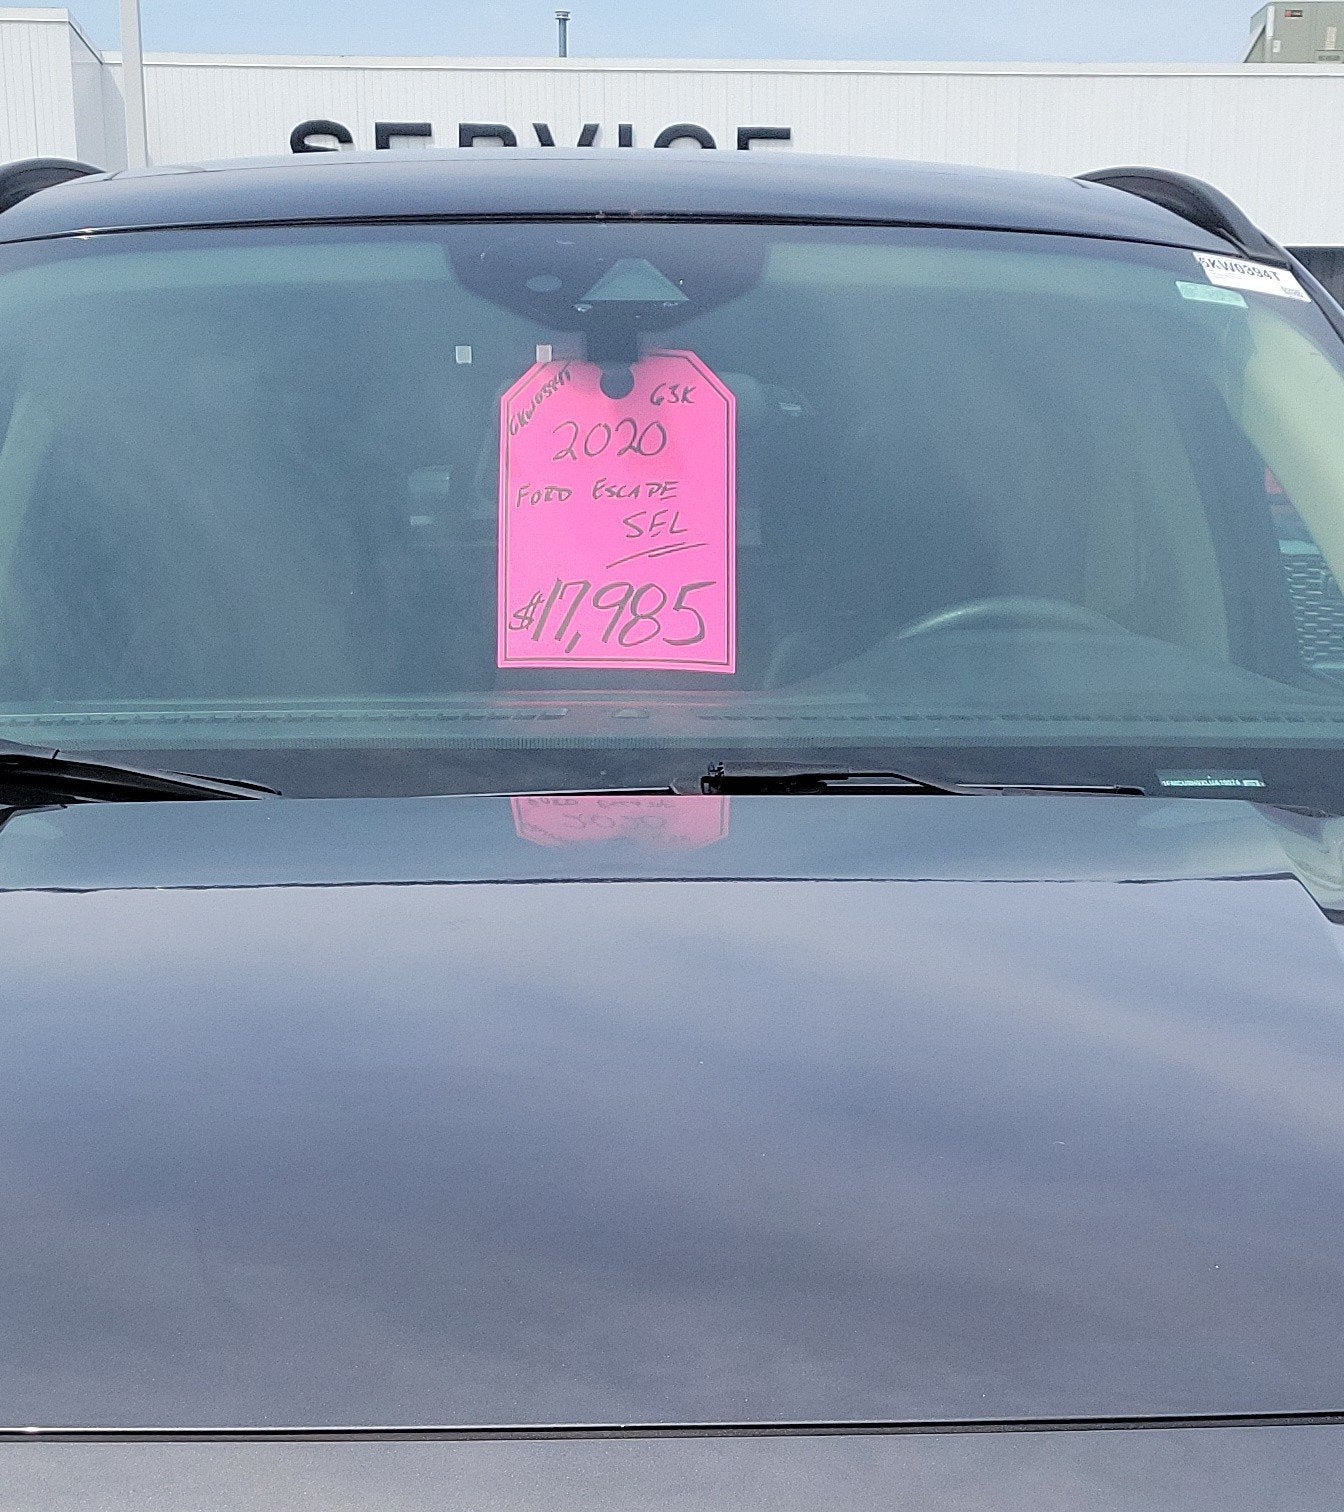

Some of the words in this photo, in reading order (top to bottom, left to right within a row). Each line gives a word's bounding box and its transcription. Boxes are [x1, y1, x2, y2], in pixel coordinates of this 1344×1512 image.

[553, 416, 667, 461] 2020
[516, 483, 573, 508] FORD
[592, 478, 680, 500] ESCAPE
[622, 509, 689, 539] SEL
[508, 577, 717, 654] $17,985
